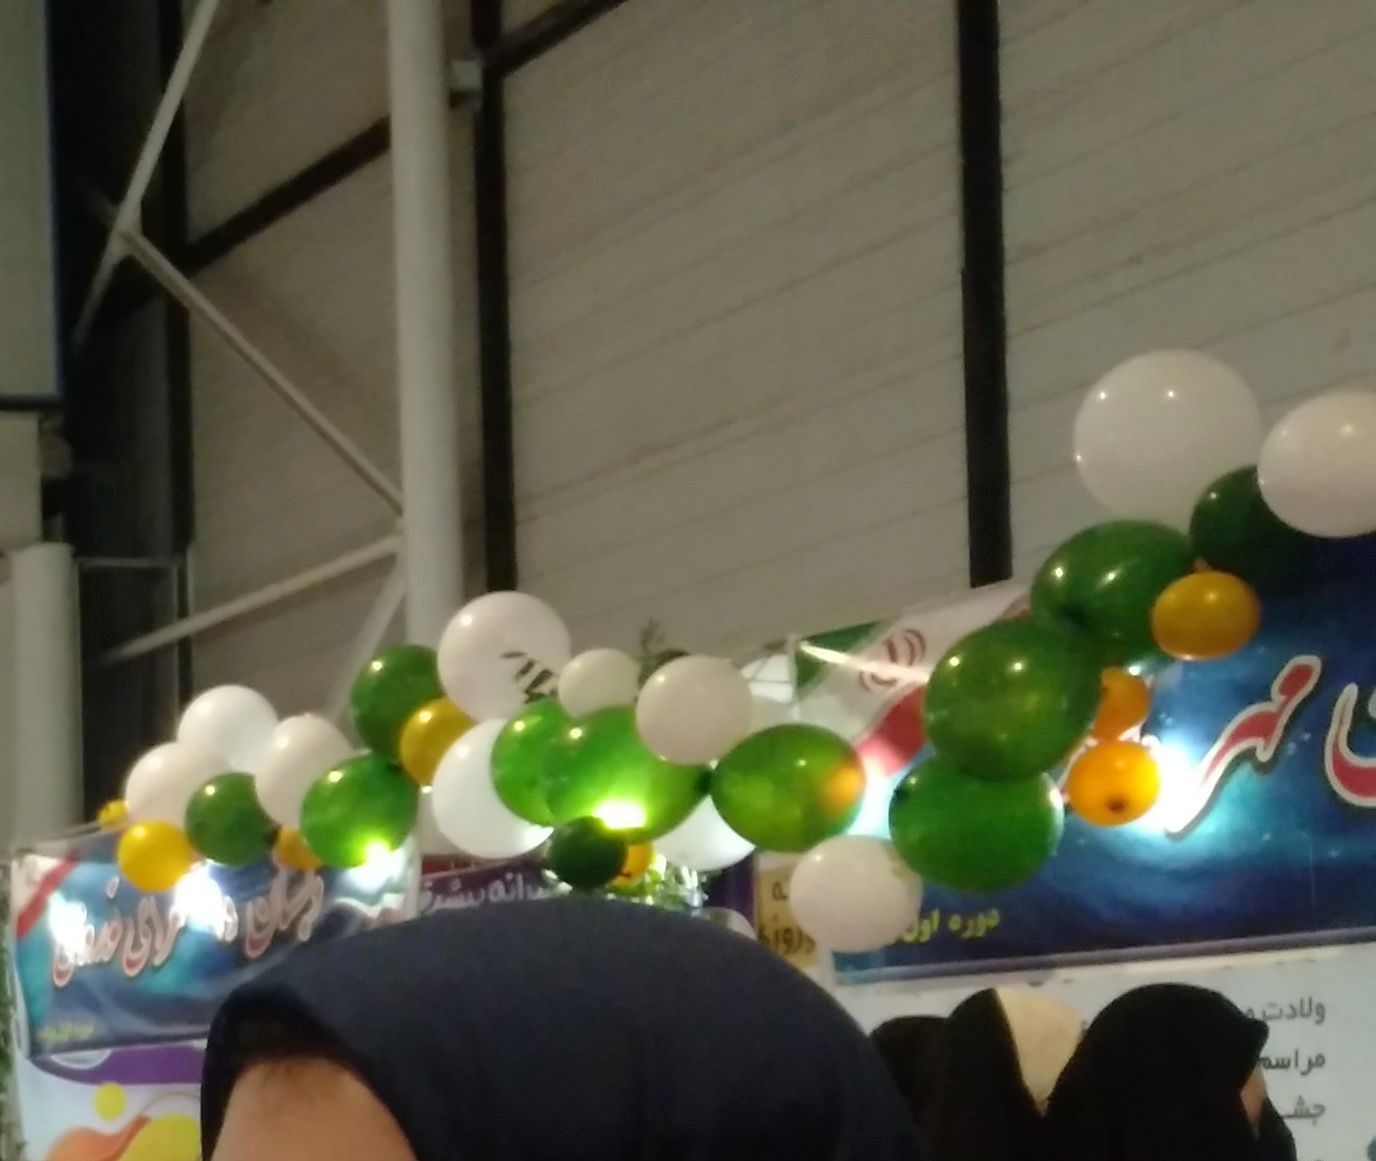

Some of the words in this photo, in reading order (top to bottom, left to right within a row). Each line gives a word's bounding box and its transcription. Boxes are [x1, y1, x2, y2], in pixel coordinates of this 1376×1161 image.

[947, 906, 1002, 938] دوره
[1262, 996, 1327, 1026] ولادت
[1280, 1094, 1327, 1127] جش
